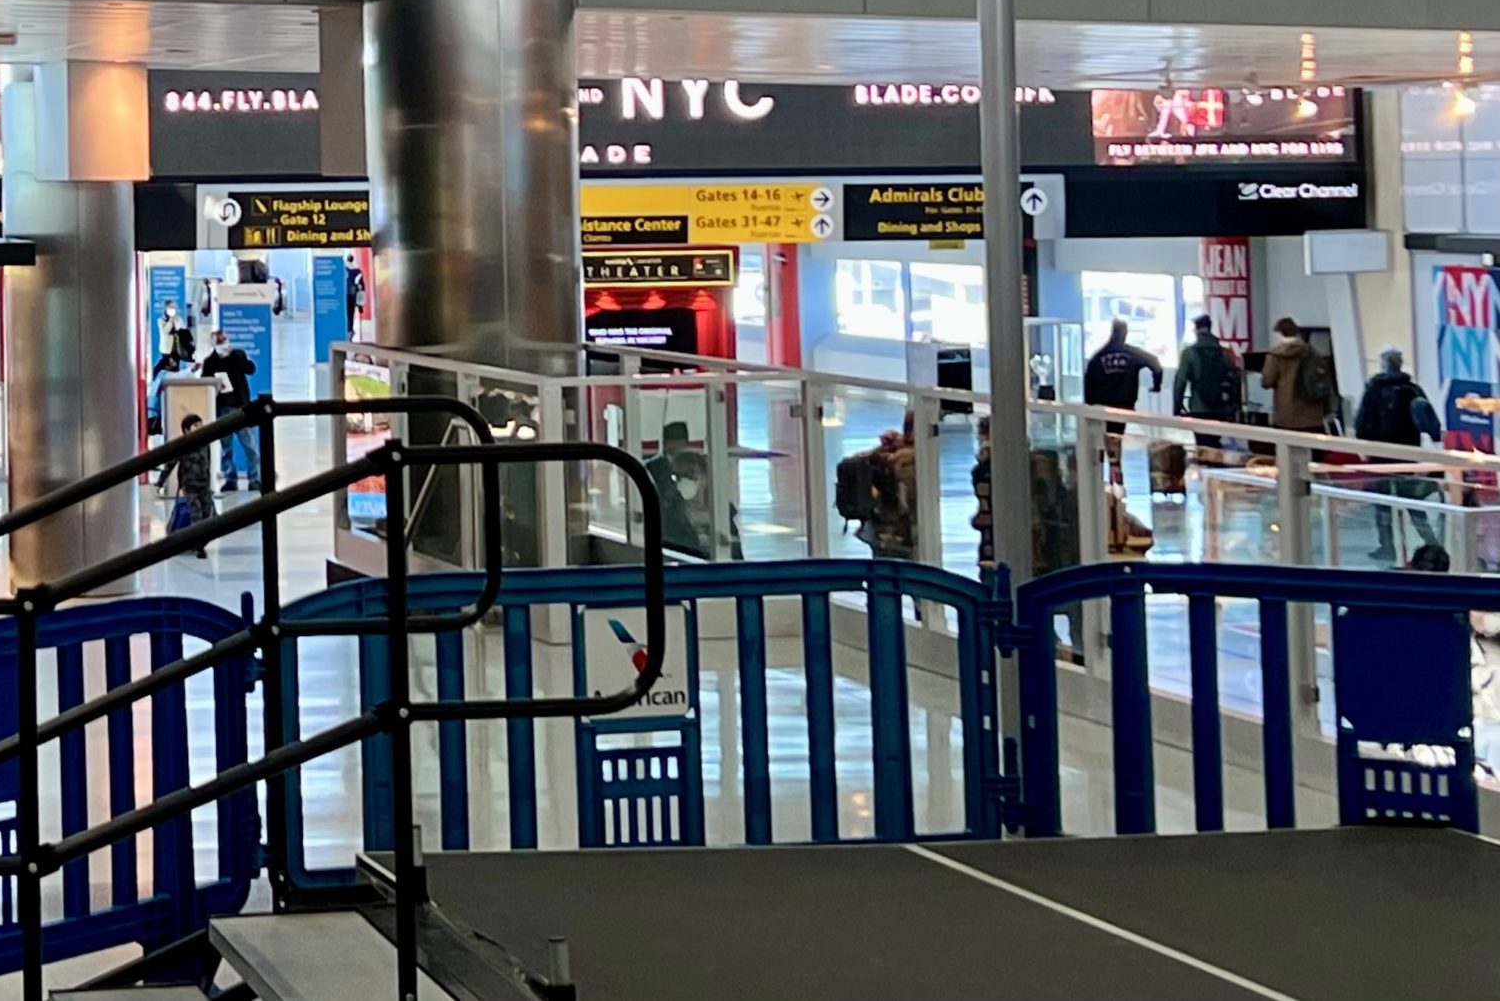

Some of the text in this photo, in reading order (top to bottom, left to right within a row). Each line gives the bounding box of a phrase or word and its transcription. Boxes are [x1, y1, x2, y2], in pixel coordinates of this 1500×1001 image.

[621, 77, 775, 120] NYC
[695, 188, 781, 202] Gates 14-16
[869, 186, 986, 204] Admirals Club
[1259, 183, 1359, 199] Clear Channel
[272, 199, 368, 214] Flagship Lounge
[279, 213, 327, 226] Gate 12
[634, 218, 681, 232] Center
[695, 215, 781, 229] Gates 31-47
[877, 220, 981, 235] Dining and Shops
[286, 229, 328, 243] Dining
[330, 228, 354, 241] and
